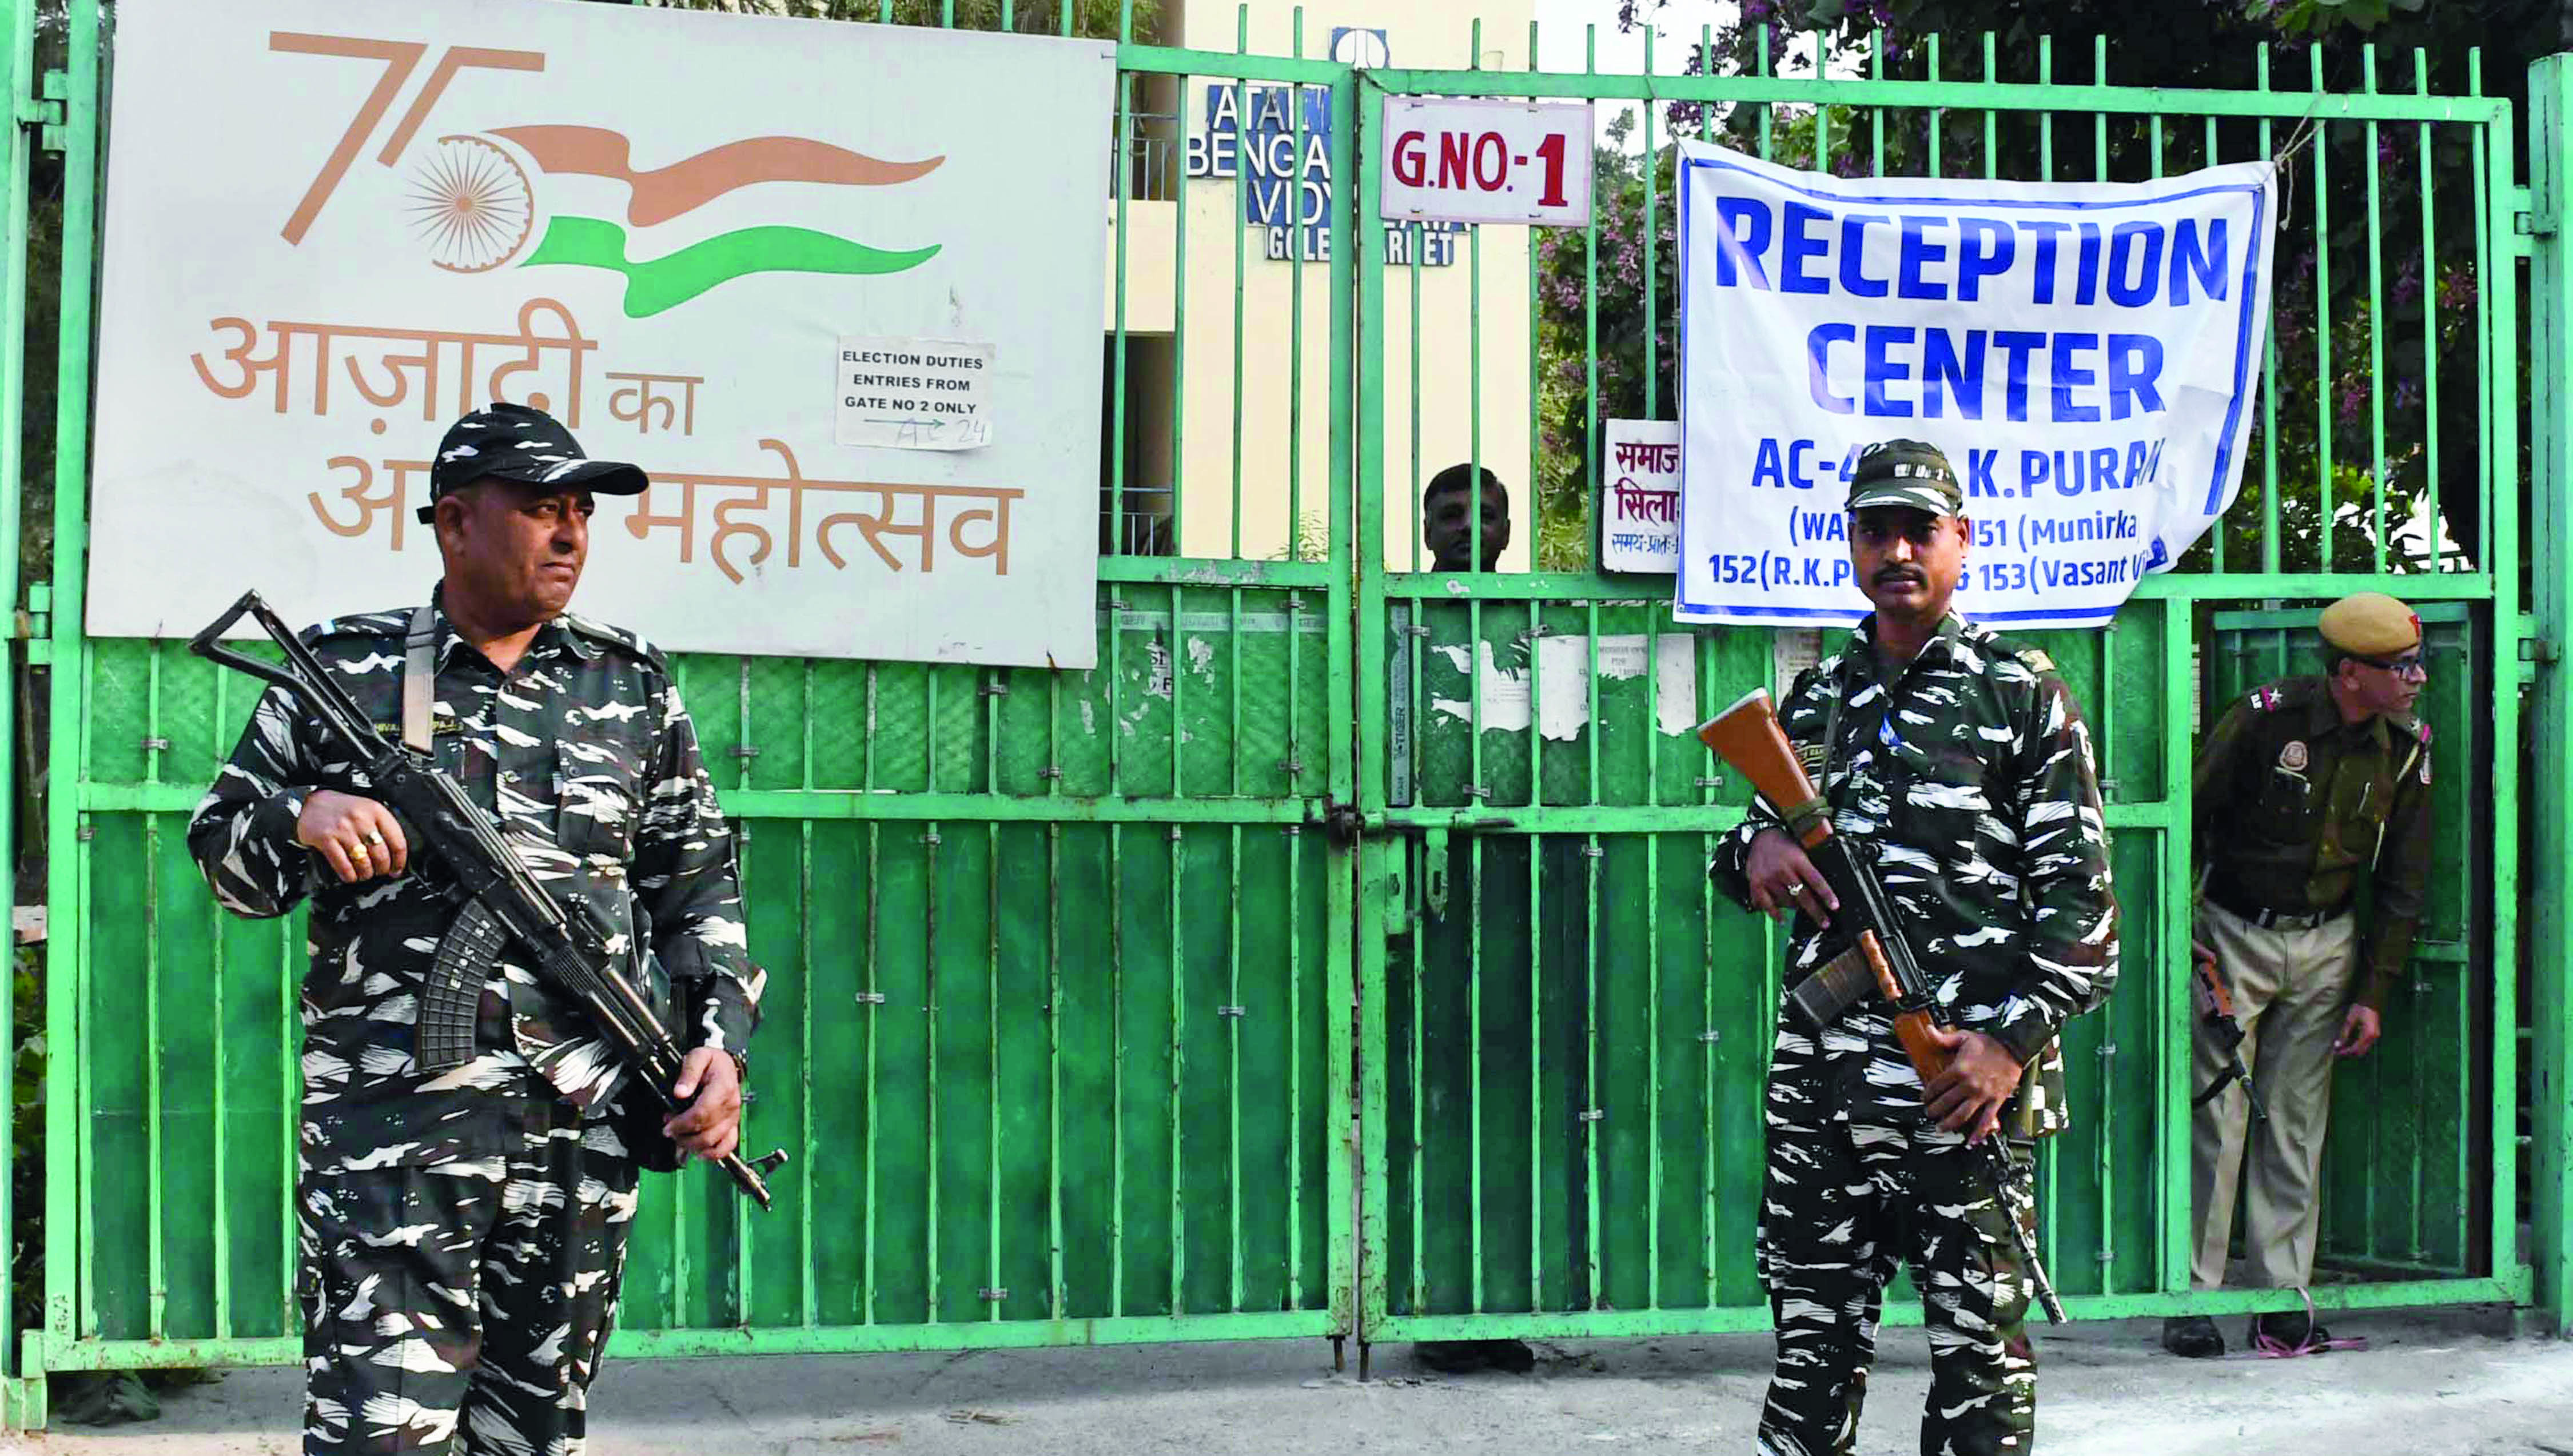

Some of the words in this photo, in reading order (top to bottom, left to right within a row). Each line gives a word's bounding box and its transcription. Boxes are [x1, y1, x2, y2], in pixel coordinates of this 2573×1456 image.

[1187, 131, 1332, 178] BENGA
[1716, 196, 2228, 309] RECEPTION
[190, 297, 598, 435] आज़ादी
[605, 372, 704, 436] का
[842, 351, 921, 366] ELECTION
[926, 356, 983, 370] DUTIES
[854, 374, 921, 389] ENTRIES
[926, 378, 971, 392] FROM
[1806, 322, 2167, 422] CENTER
[845, 396, 887, 409] GATE
[893, 399, 915, 410] NO
[921, 401, 929, 412] 2
[934, 401, 977, 414] ONLY
[1751, 438, 1862, 489] AC-4
[624, 439, 1025, 585] महोत्सव
[1615, 477, 1680, 526] सिला
